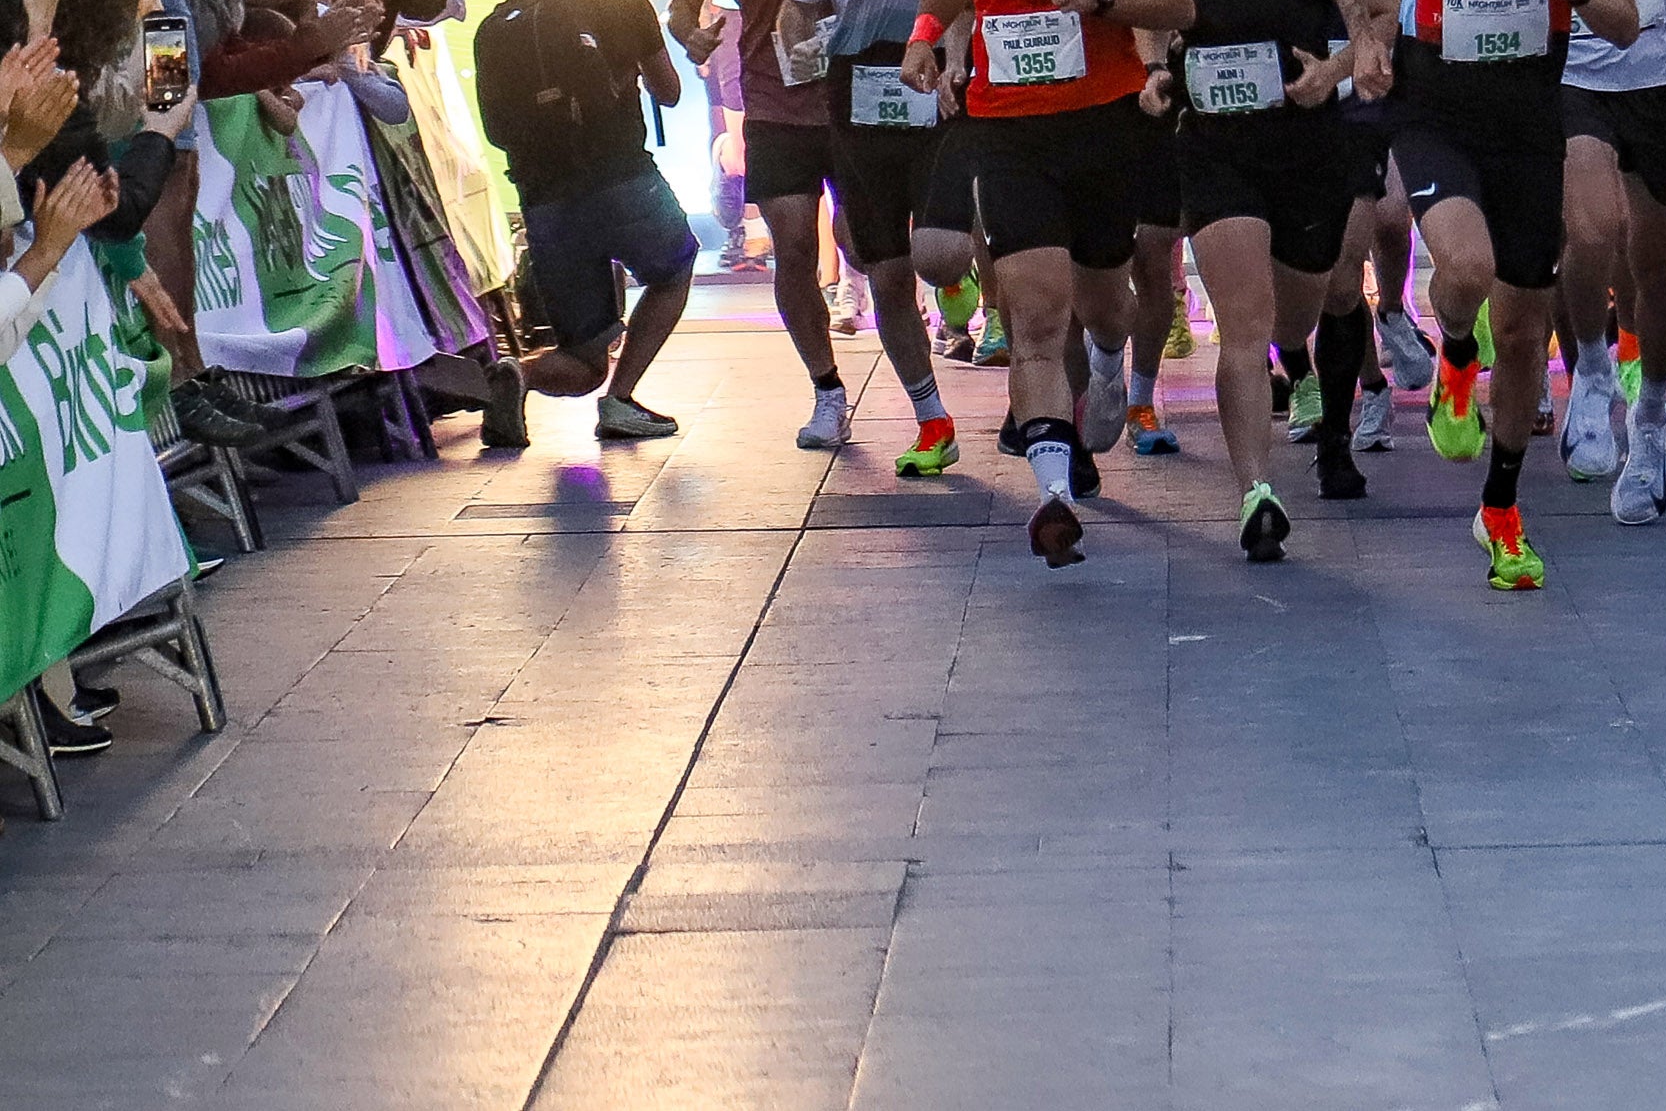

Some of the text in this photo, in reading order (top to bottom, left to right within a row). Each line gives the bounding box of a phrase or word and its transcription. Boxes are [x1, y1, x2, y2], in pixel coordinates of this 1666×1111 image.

[1003, 38, 1022, 50] PAUL
[1475, 31, 1521, 55] 1534
[1012, 52, 1056, 76] 1355
[1209, 82, 1258, 106] F1153
[878, 101, 909, 120] 834
